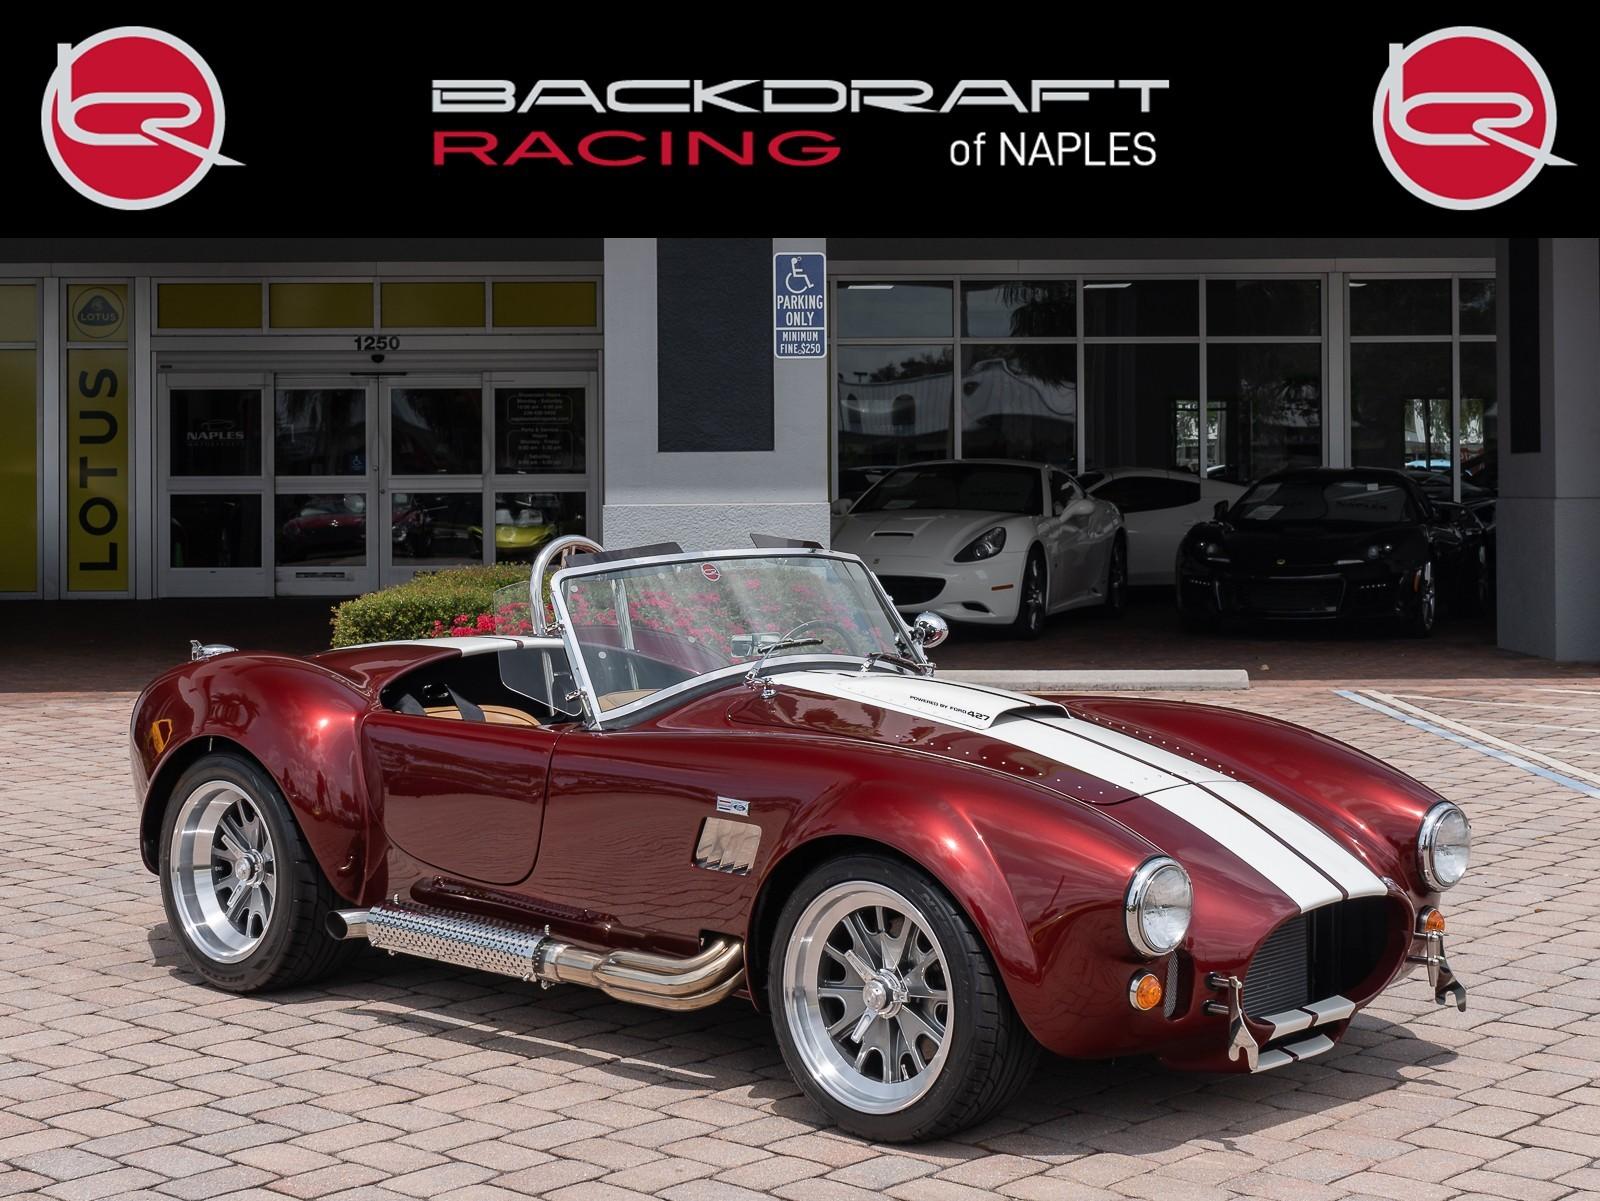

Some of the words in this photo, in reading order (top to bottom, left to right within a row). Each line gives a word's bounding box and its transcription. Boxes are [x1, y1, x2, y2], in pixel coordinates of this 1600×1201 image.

[777, 295, 823, 309] PARKING
[80, 312, 116, 321] LOTUS
[786, 312, 814, 326] ONLY
[353, 335, 400, 351] 1250
[782, 332, 818, 341] MINIMUM
[780, 344, 798, 354] FINE
[801, 343, 821, 354] $250
[186, 431, 245, 441] NAPLES
[78, 368, 118, 571] LOTUS
[910, 696, 938, 706] POWERED
[949, 706, 967, 714] FORD
[967, 710, 990, 721] 427
